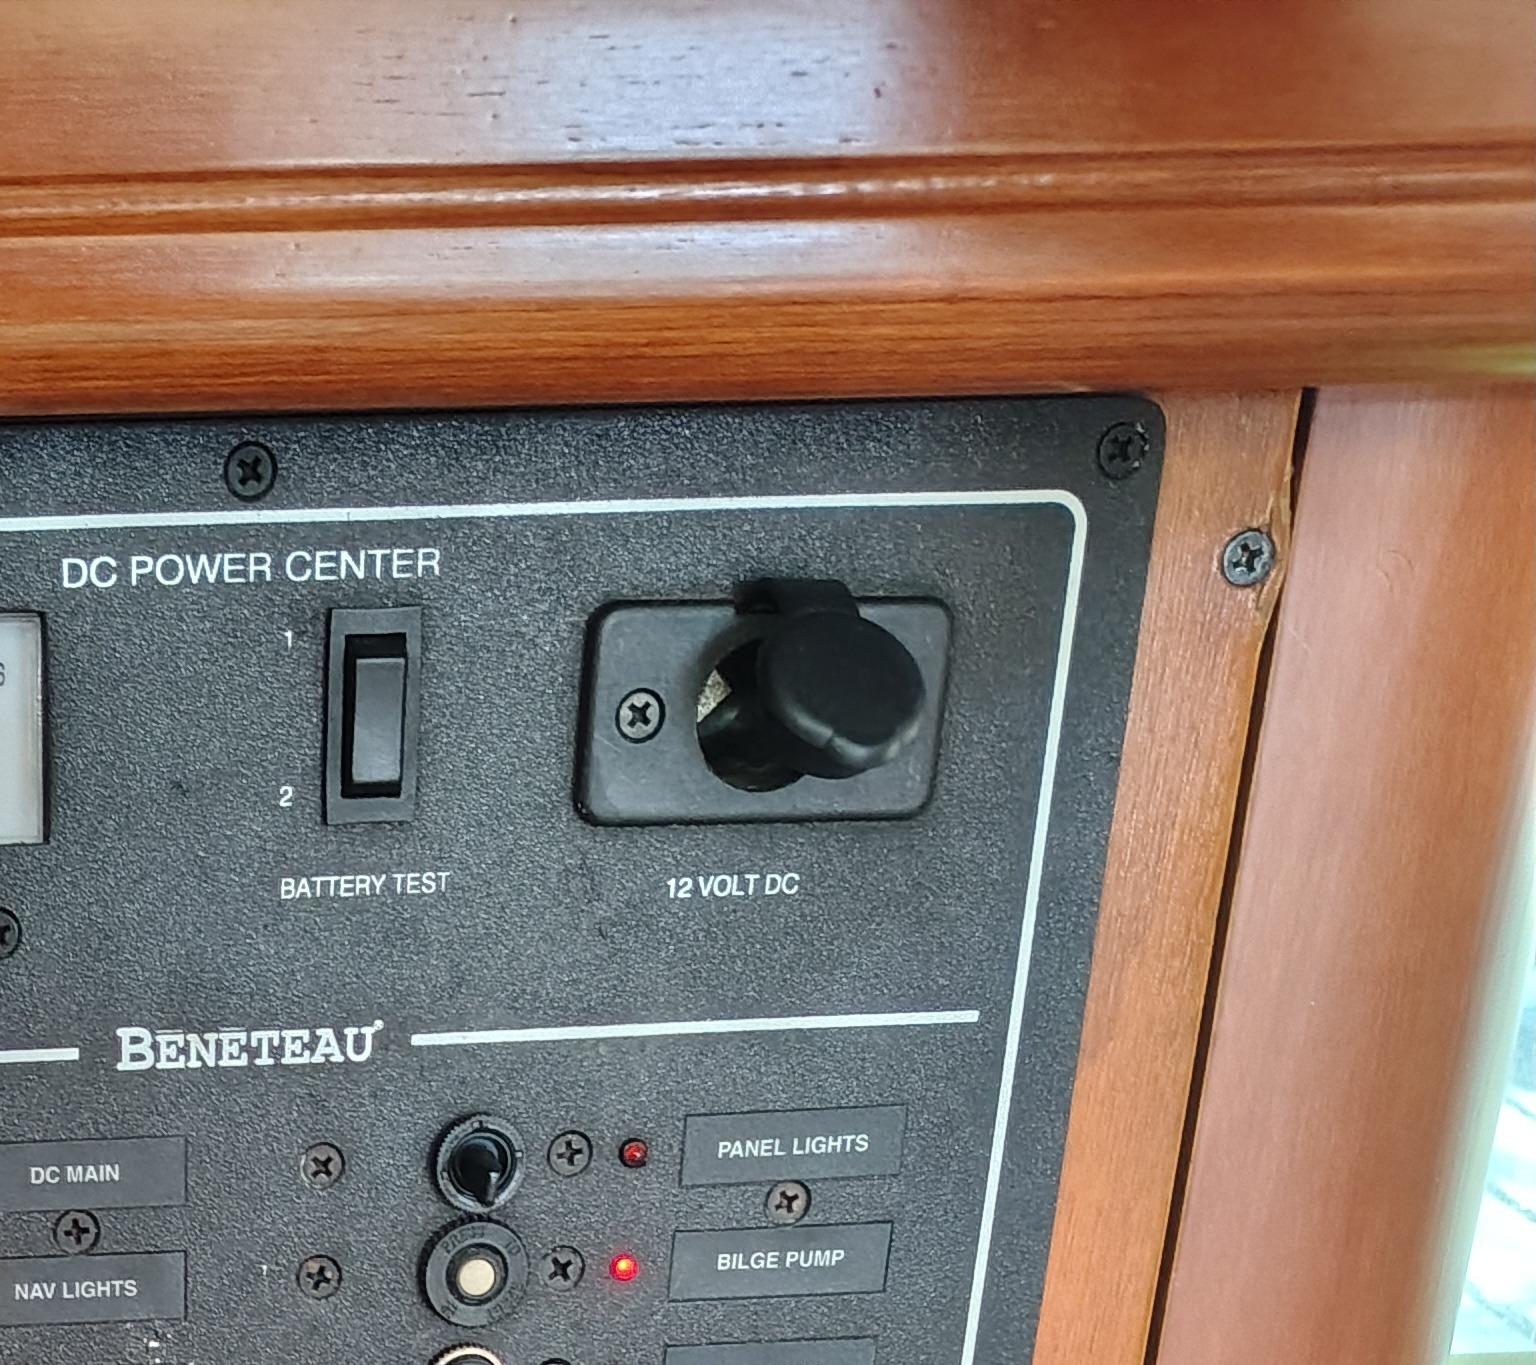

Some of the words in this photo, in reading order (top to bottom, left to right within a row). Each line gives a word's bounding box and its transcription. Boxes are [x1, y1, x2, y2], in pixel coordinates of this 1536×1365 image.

[62, 556, 118, 589] DC
[130, 551, 271, 585] POWER
[285, 547, 442, 582] CENTER
[285, 631, 293, 648] 1
[279, 787, 293, 806] 2
[279, 875, 385, 898] BATTERY
[392, 872, 450, 894] TEST
[666, 877, 690, 898] 12
[696, 875, 760, 897] VOLT
[765, 874, 800, 895] DC
[718, 1137, 786, 1158] PANEL
[792, 1134, 869, 1155] LIGHTS
[31, 1166, 60, 1183] DC
[66, 1164, 120, 1182] MAIN
[717, 1252, 781, 1270] BILGE
[787, 1249, 845, 1269] PUMP
[14, 1282, 57, 1300] NAV
[63, 1280, 138, 1298] LIGHTS
